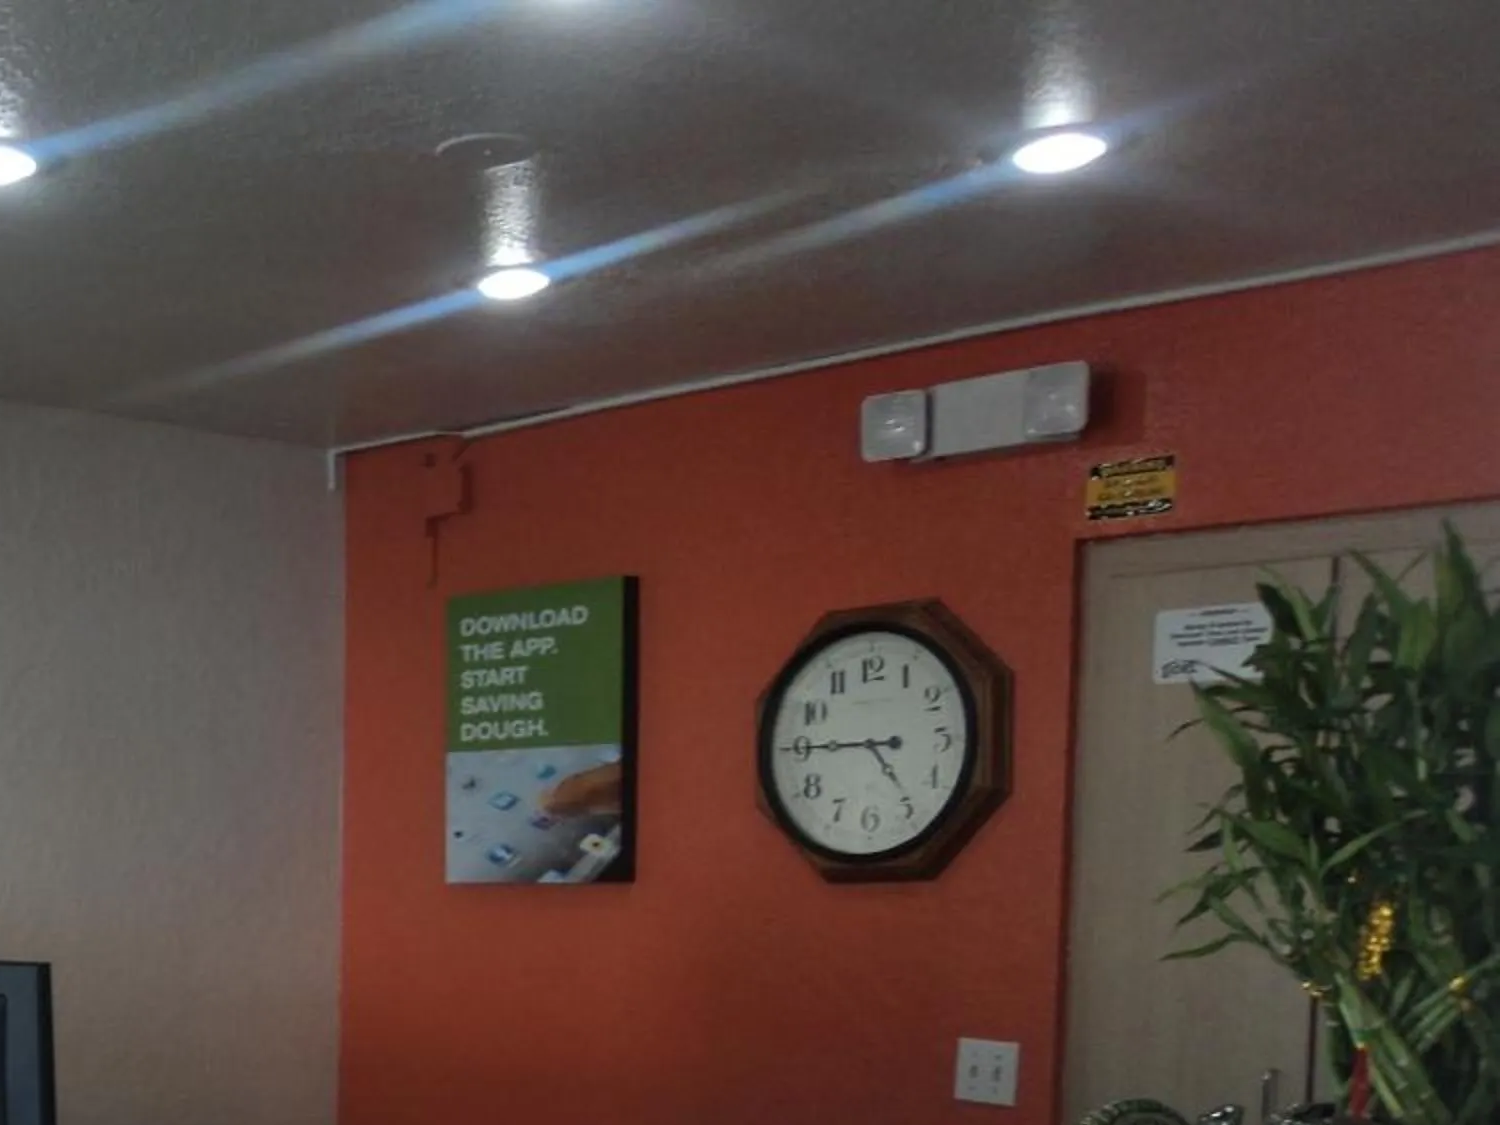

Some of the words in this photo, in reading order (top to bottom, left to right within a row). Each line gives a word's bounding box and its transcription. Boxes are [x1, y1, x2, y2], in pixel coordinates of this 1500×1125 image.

[460, 606, 589, 637] DOWNLOAD
[460, 642, 503, 662] THE
[510, 637, 558, 657] APP.
[460, 666, 528, 688] START
[830, 670, 846, 695] 11
[862, 656, 886, 684] 12
[902, 664, 909, 688] 1
[460, 692, 543, 715] SAVING
[924, 686, 942, 711] 2
[804, 701, 827, 726] 10
[460, 719, 548, 741] DOUGH.
[933, 727, 951, 752] 3
[792, 735, 811, 762] 9
[804, 773, 822, 799] 8
[832, 798, 847, 822] 7
[860, 806, 880, 832] 6
